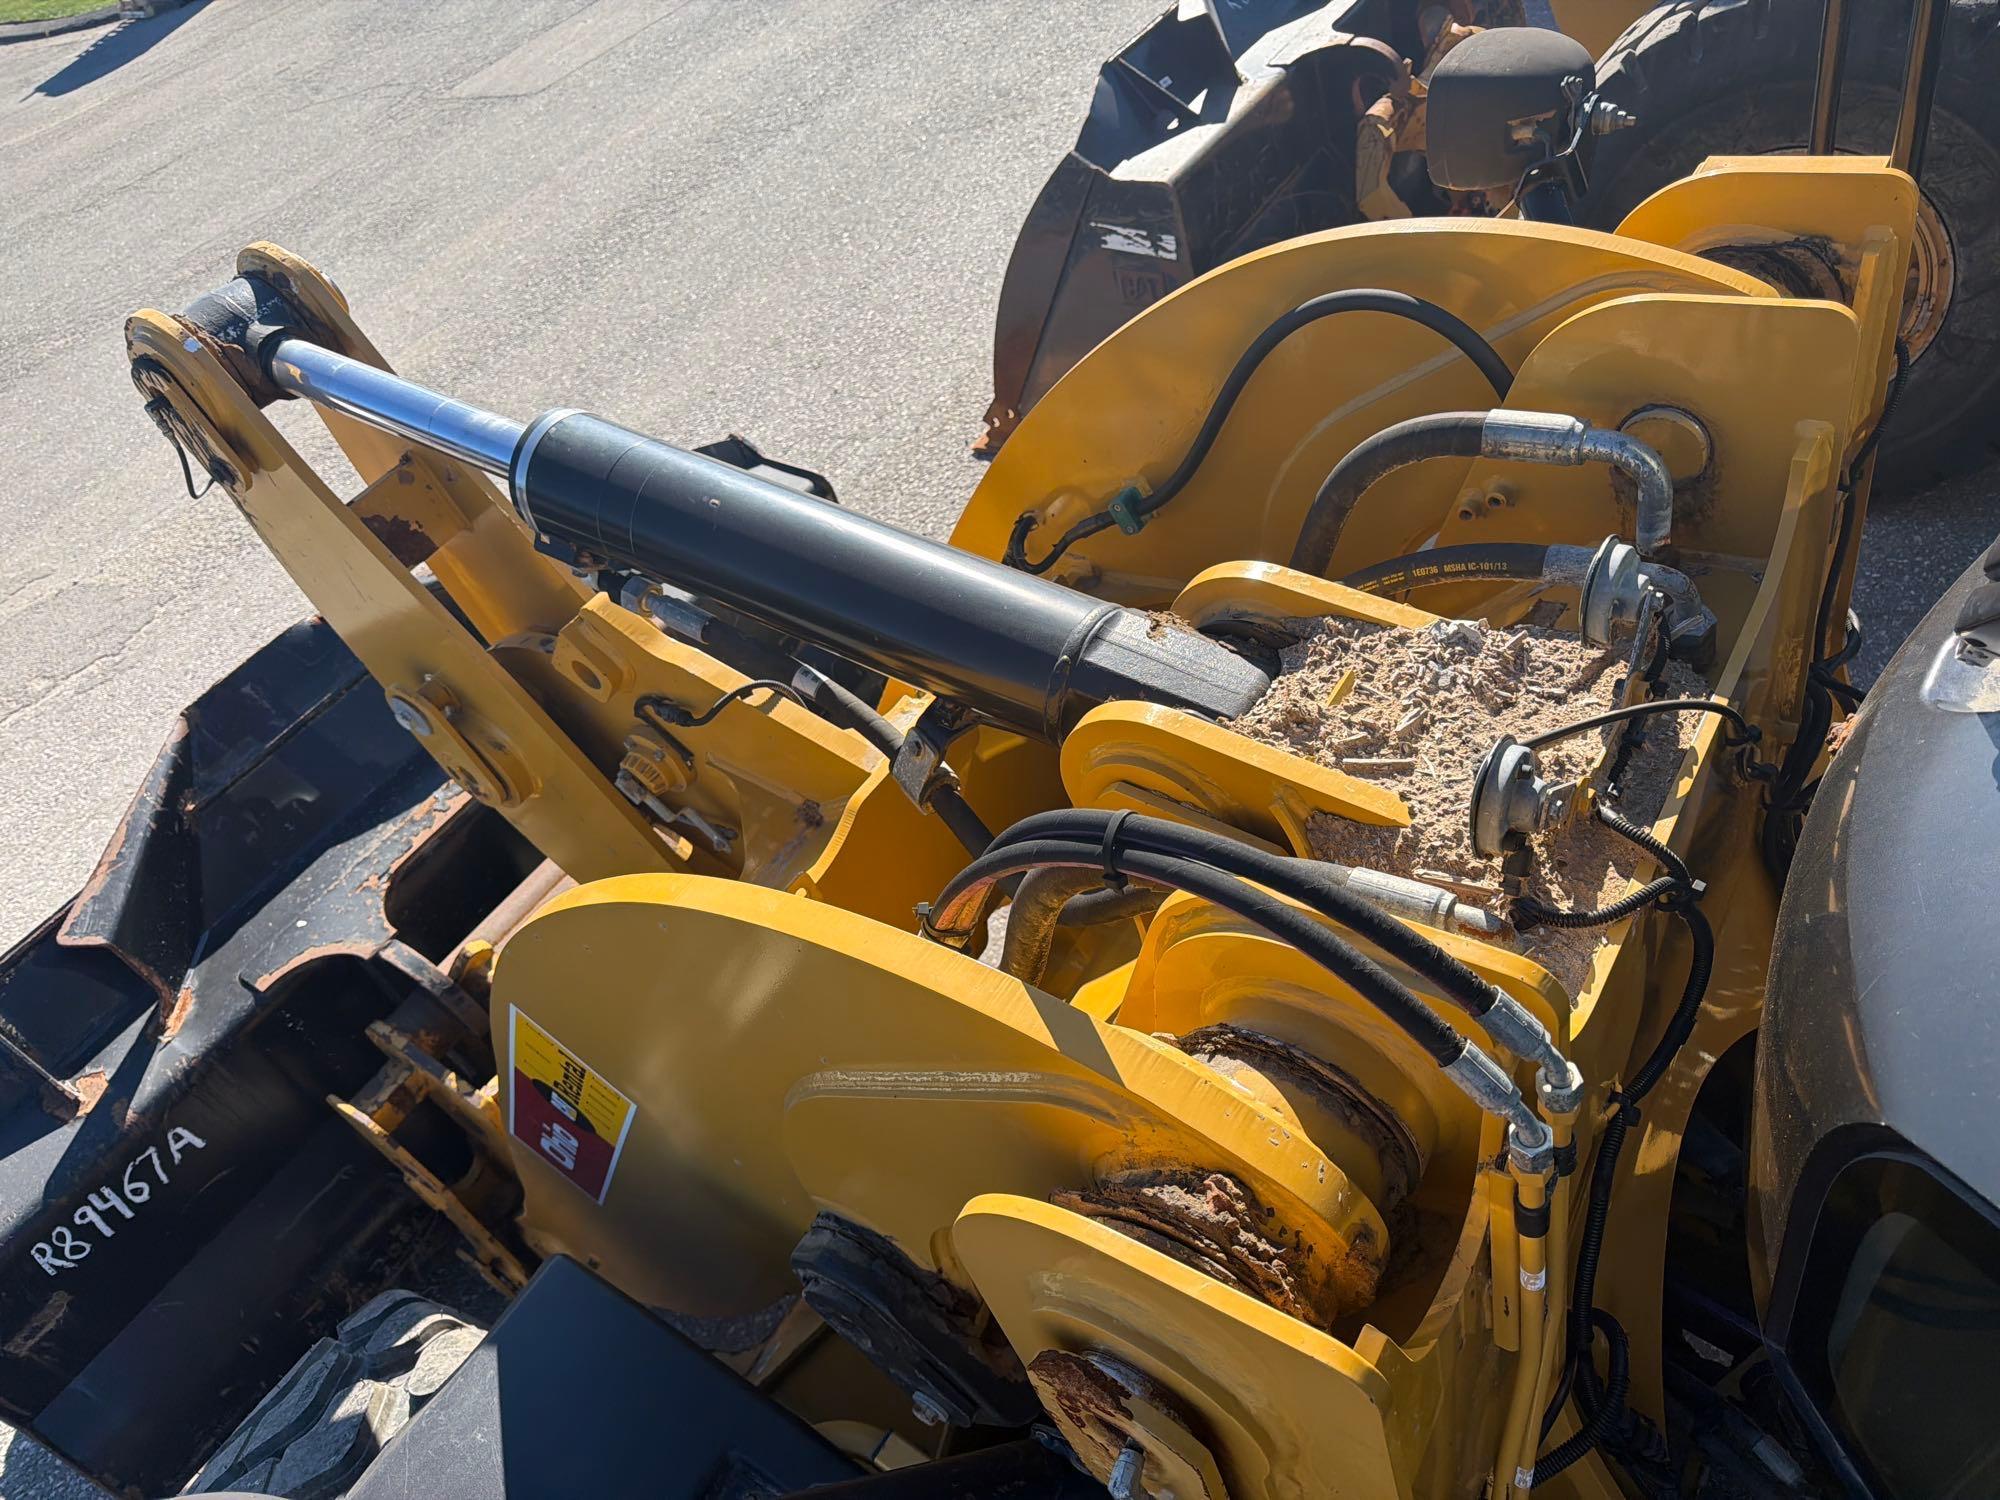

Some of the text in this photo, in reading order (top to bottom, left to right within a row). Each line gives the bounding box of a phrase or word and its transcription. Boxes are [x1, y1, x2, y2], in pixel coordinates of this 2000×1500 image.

[1443, 563, 1466, 574] MSHA
[553, 1048, 587, 1105] Rental
[540, 1122, 579, 1171] Ohio
[30, 1126, 206, 1276] R89467A
